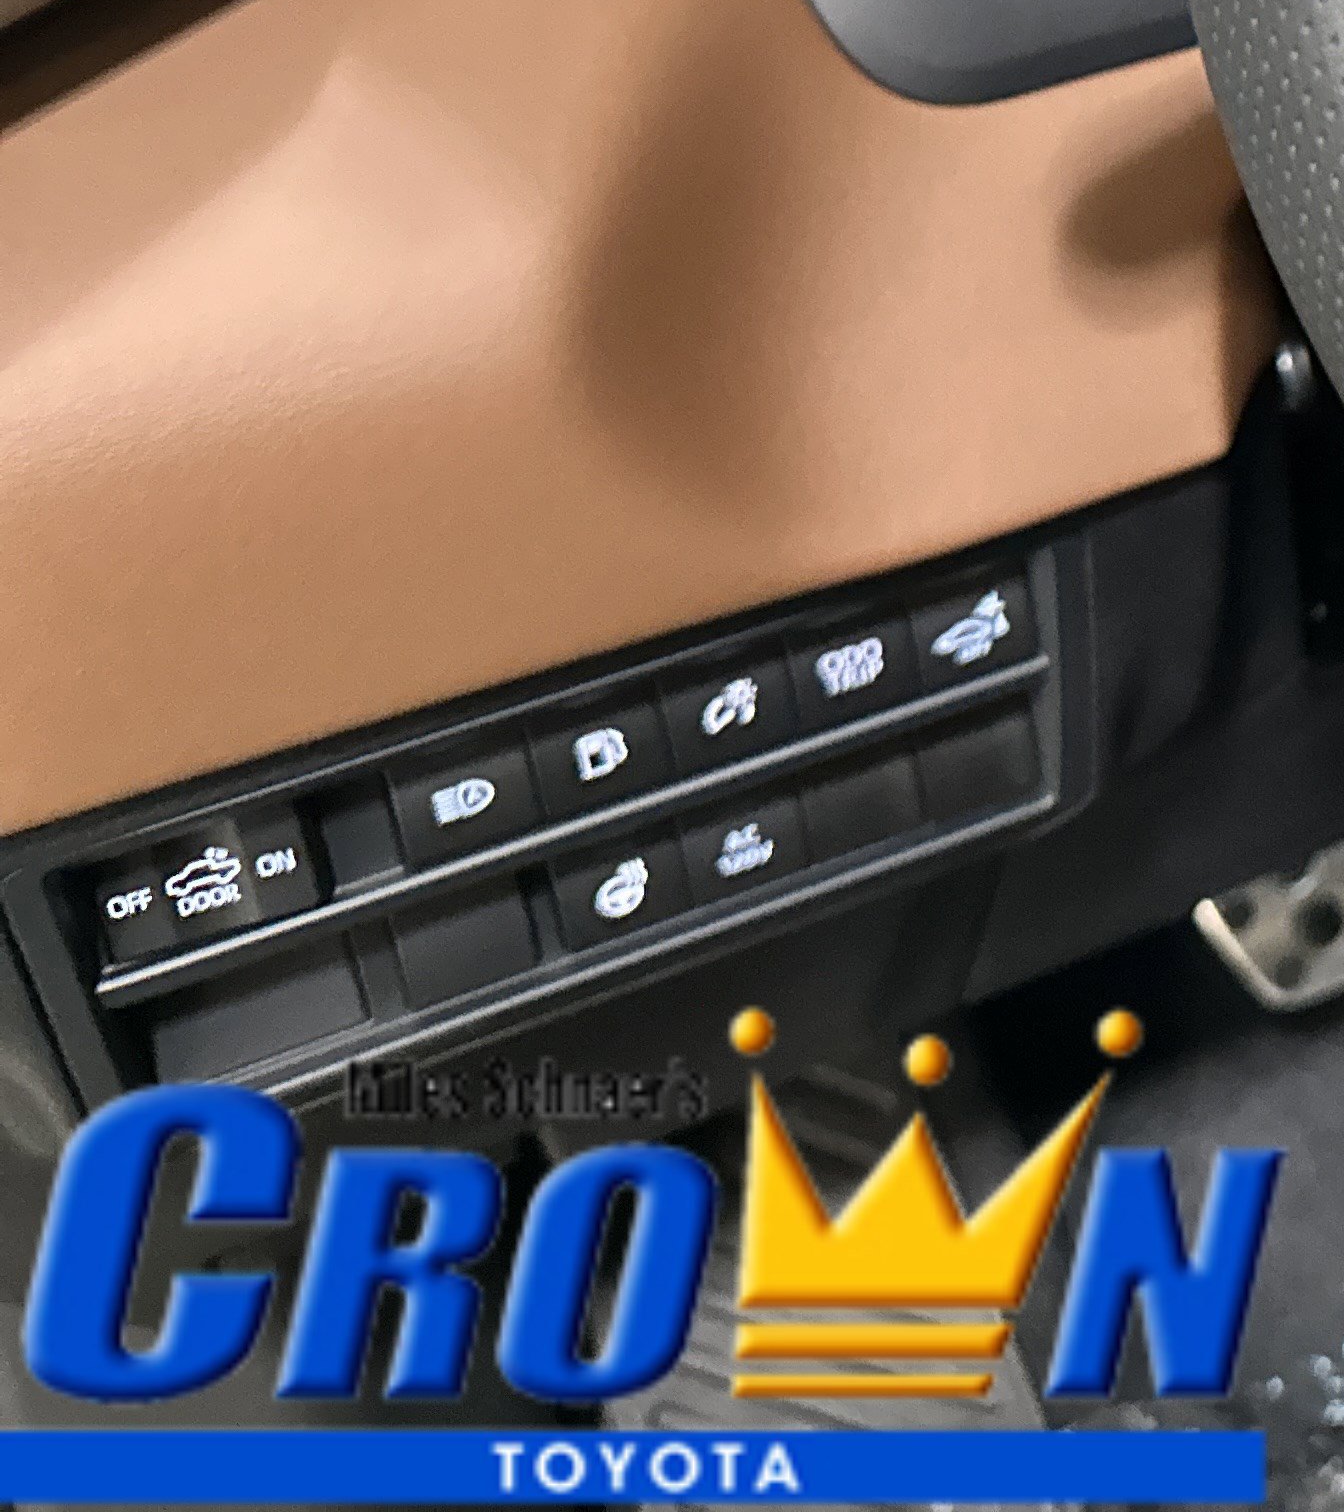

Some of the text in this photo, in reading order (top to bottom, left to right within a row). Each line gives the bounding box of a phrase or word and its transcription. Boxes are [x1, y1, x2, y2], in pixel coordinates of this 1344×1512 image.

[106, 846, 298, 920] OFF ON
[176, 882, 242, 918] DOOR
